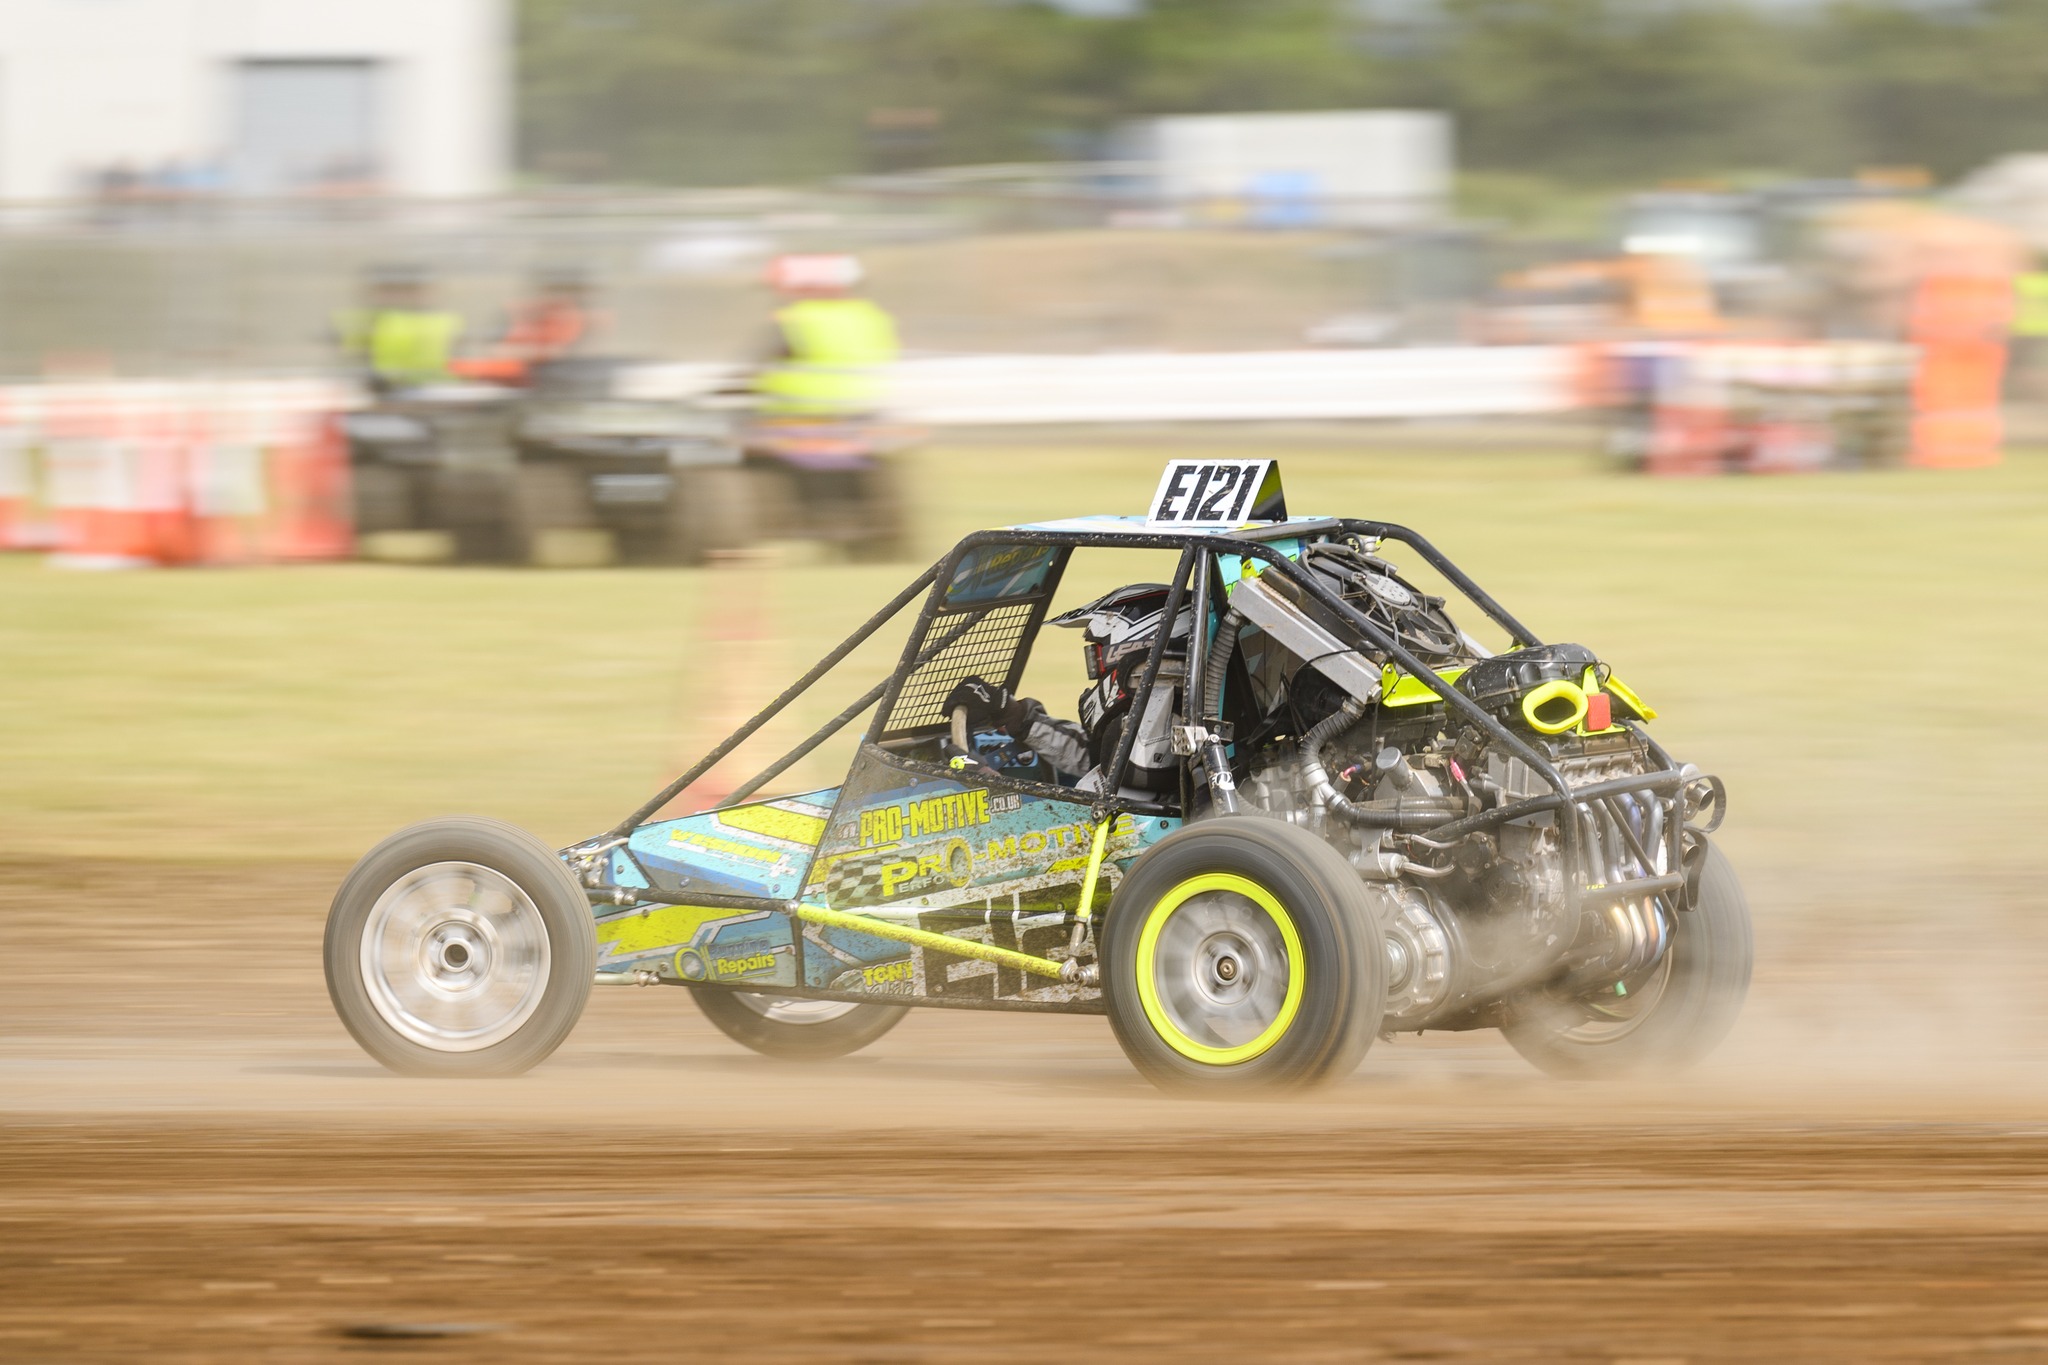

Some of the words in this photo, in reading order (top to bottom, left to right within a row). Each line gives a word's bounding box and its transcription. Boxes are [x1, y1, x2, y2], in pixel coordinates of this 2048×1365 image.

[1155, 465, 1260, 521] E121
[717, 953, 776, 975] Repairs
[863, 961, 913, 986] TONY
